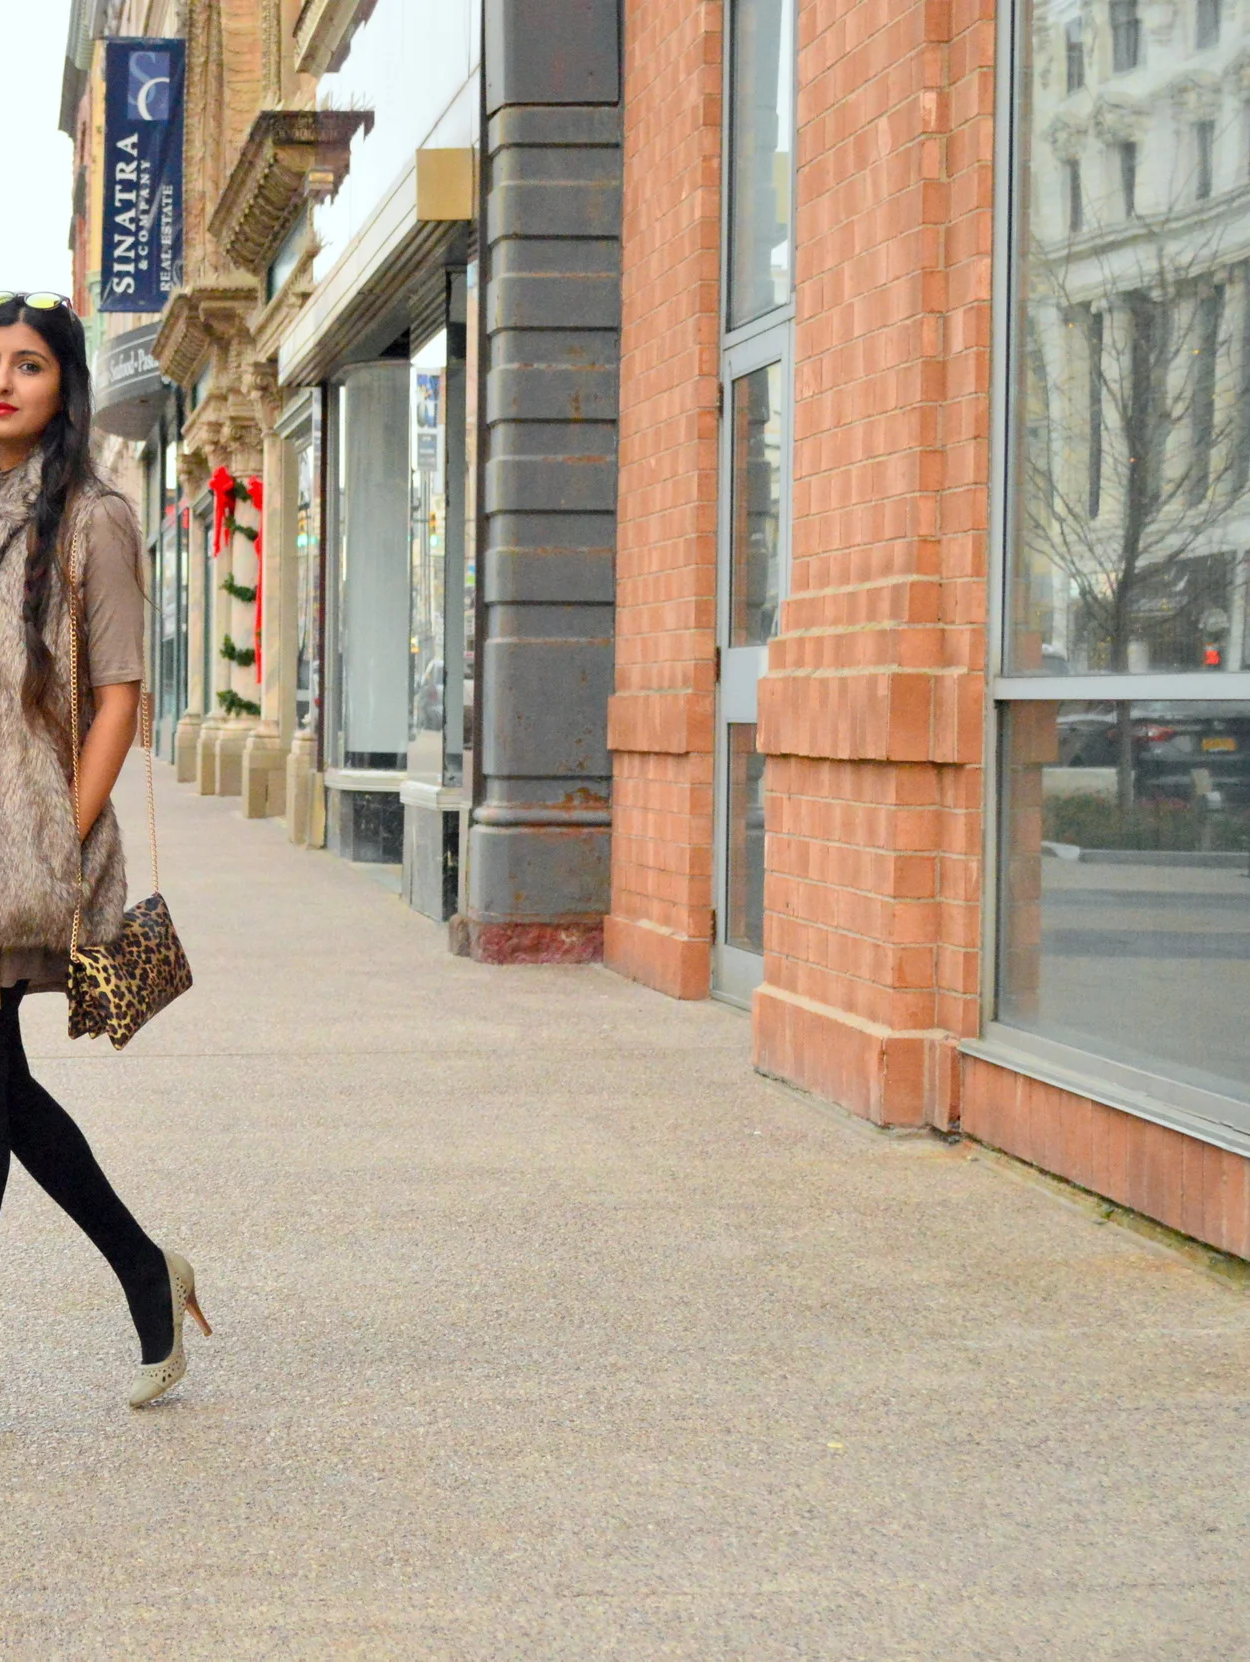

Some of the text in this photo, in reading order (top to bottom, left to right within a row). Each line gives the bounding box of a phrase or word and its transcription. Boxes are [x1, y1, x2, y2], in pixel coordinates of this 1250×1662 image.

[112, 132, 139, 294] SINATRA
[137, 159, 151, 271] & COMPANY
[160, 184, 174, 292] REAL ESTATE
